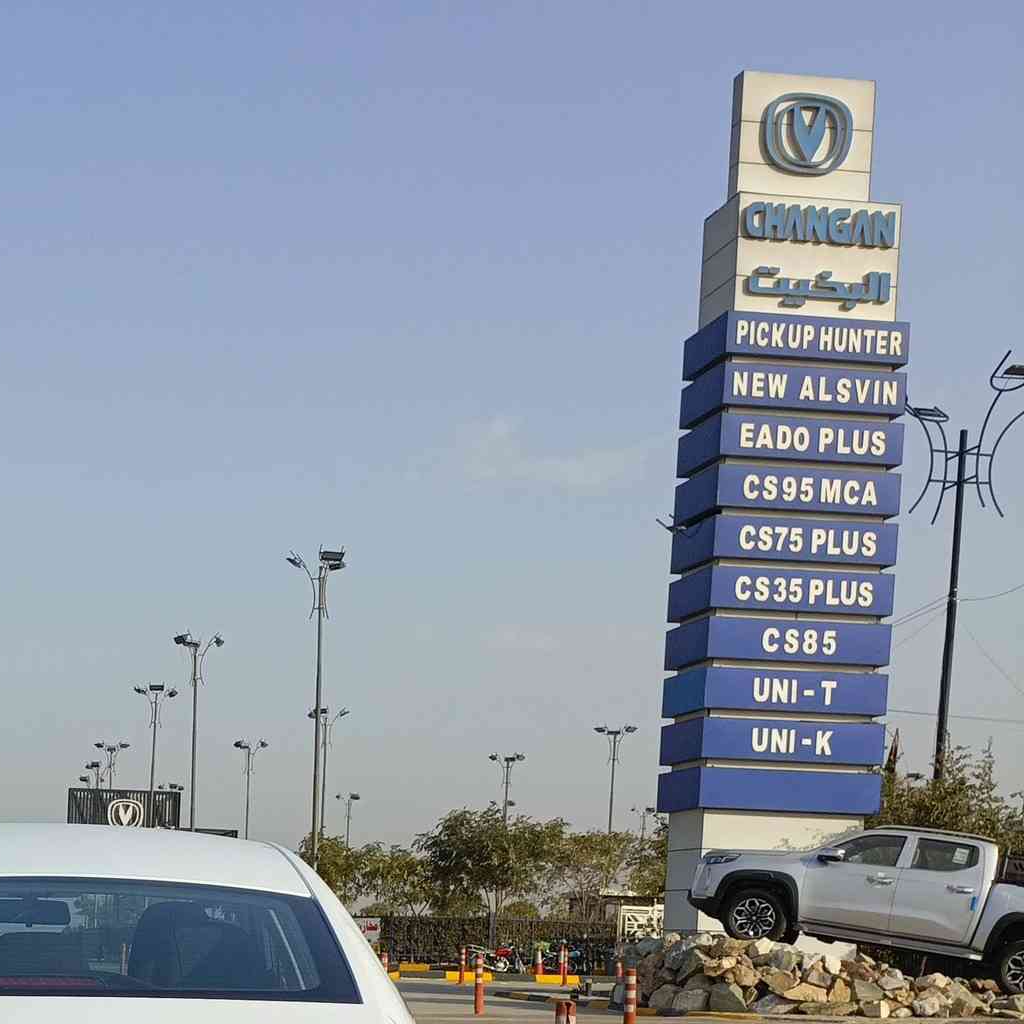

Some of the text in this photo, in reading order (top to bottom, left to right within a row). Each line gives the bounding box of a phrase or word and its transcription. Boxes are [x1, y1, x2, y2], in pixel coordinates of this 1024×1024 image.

[741, 201, 897, 249] CHANGAN
[818, 326, 903, 356] HUNTER
[732, 371, 898, 406] NEW ALSVIN
[739, 423, 886, 456] EADO PLUS
[742, 474, 878, 506] CS95 MCA
[738, 525, 878, 558] CS75 PLUS
[734, 575, 874, 608] CS35 PLUS
[761, 627, 838, 655] CS85
